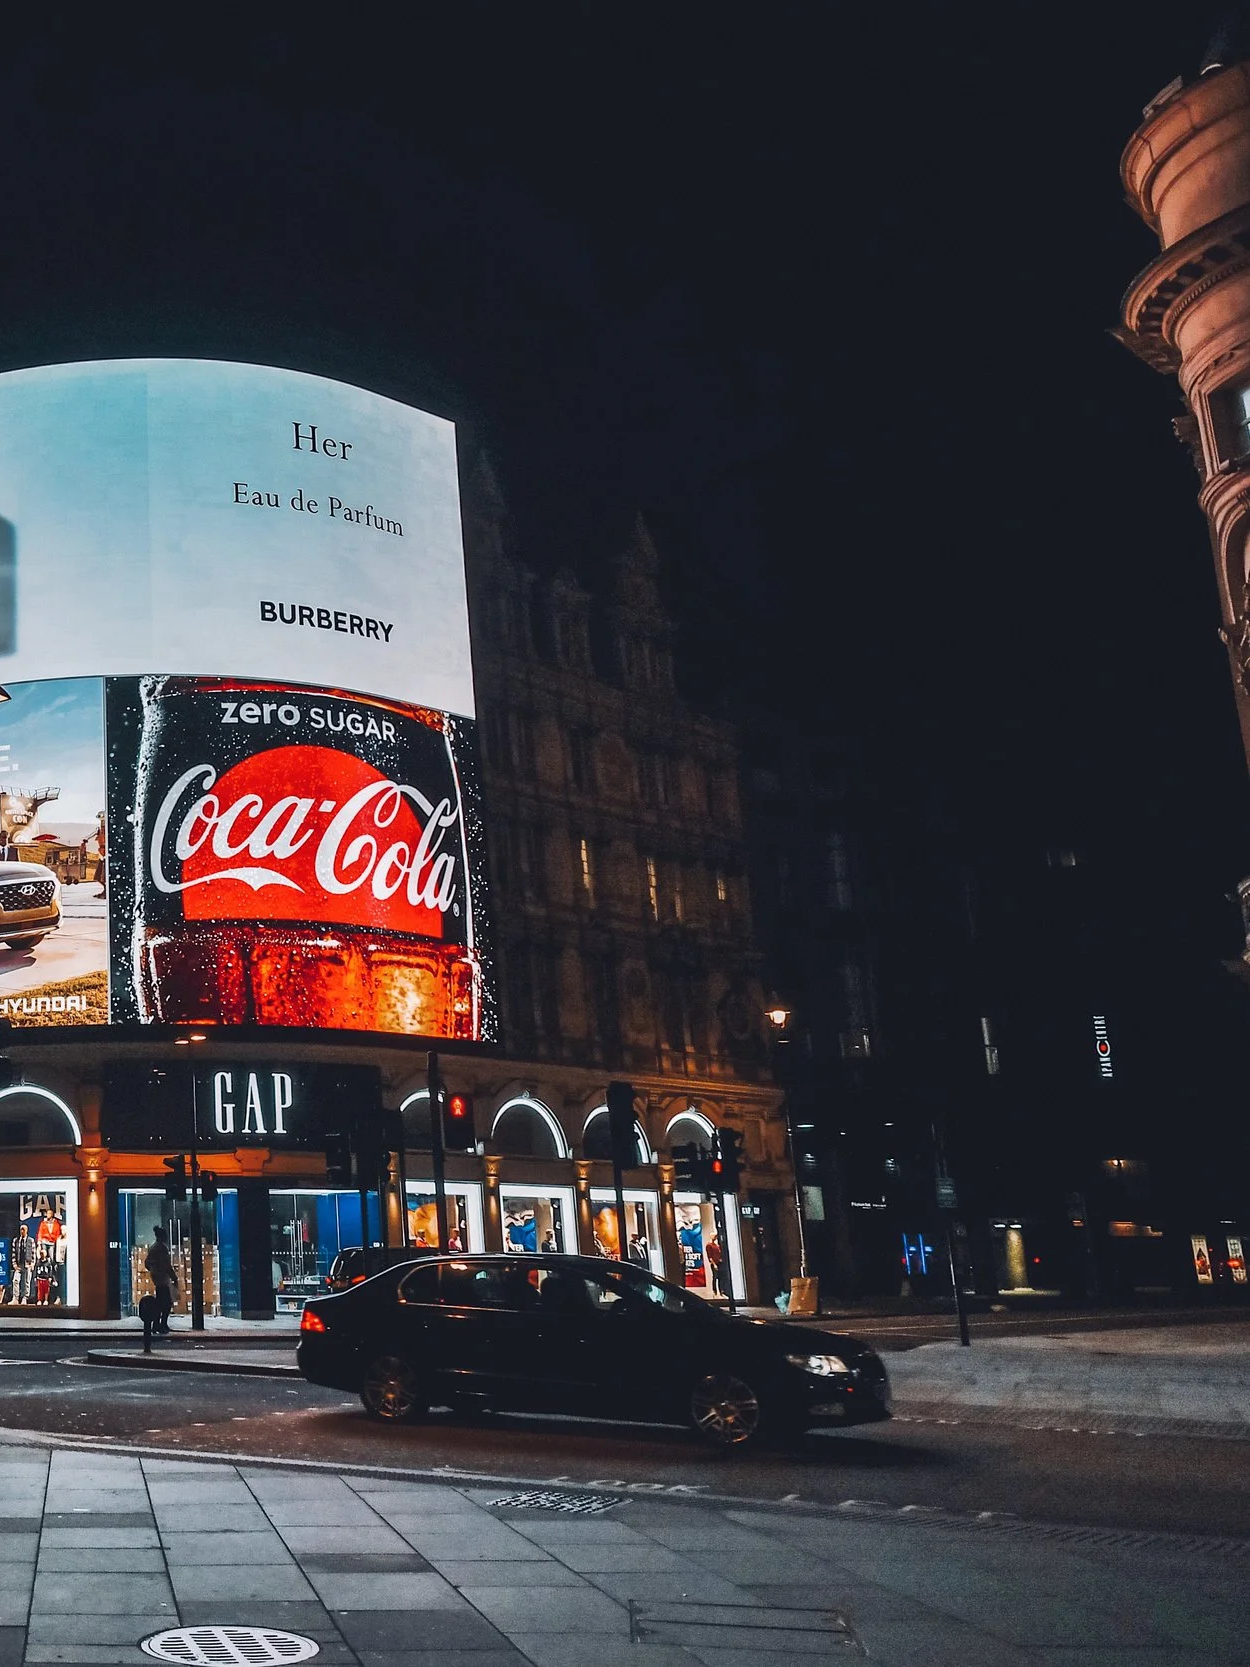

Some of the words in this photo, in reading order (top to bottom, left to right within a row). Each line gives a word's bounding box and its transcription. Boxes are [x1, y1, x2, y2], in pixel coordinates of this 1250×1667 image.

[292, 421, 353, 461] Her
[232, 482, 280, 508] Eau
[290, 489, 318, 514] de
[328, 496, 404, 537] Parfum
[260, 601, 394, 643] BURBERRY
[220, 702, 301, 726] zero
[309, 707, 396, 743] SUGAR
[150, 764, 459, 913] Coca-Cola
[214, 1072, 293, 1134] GAP
